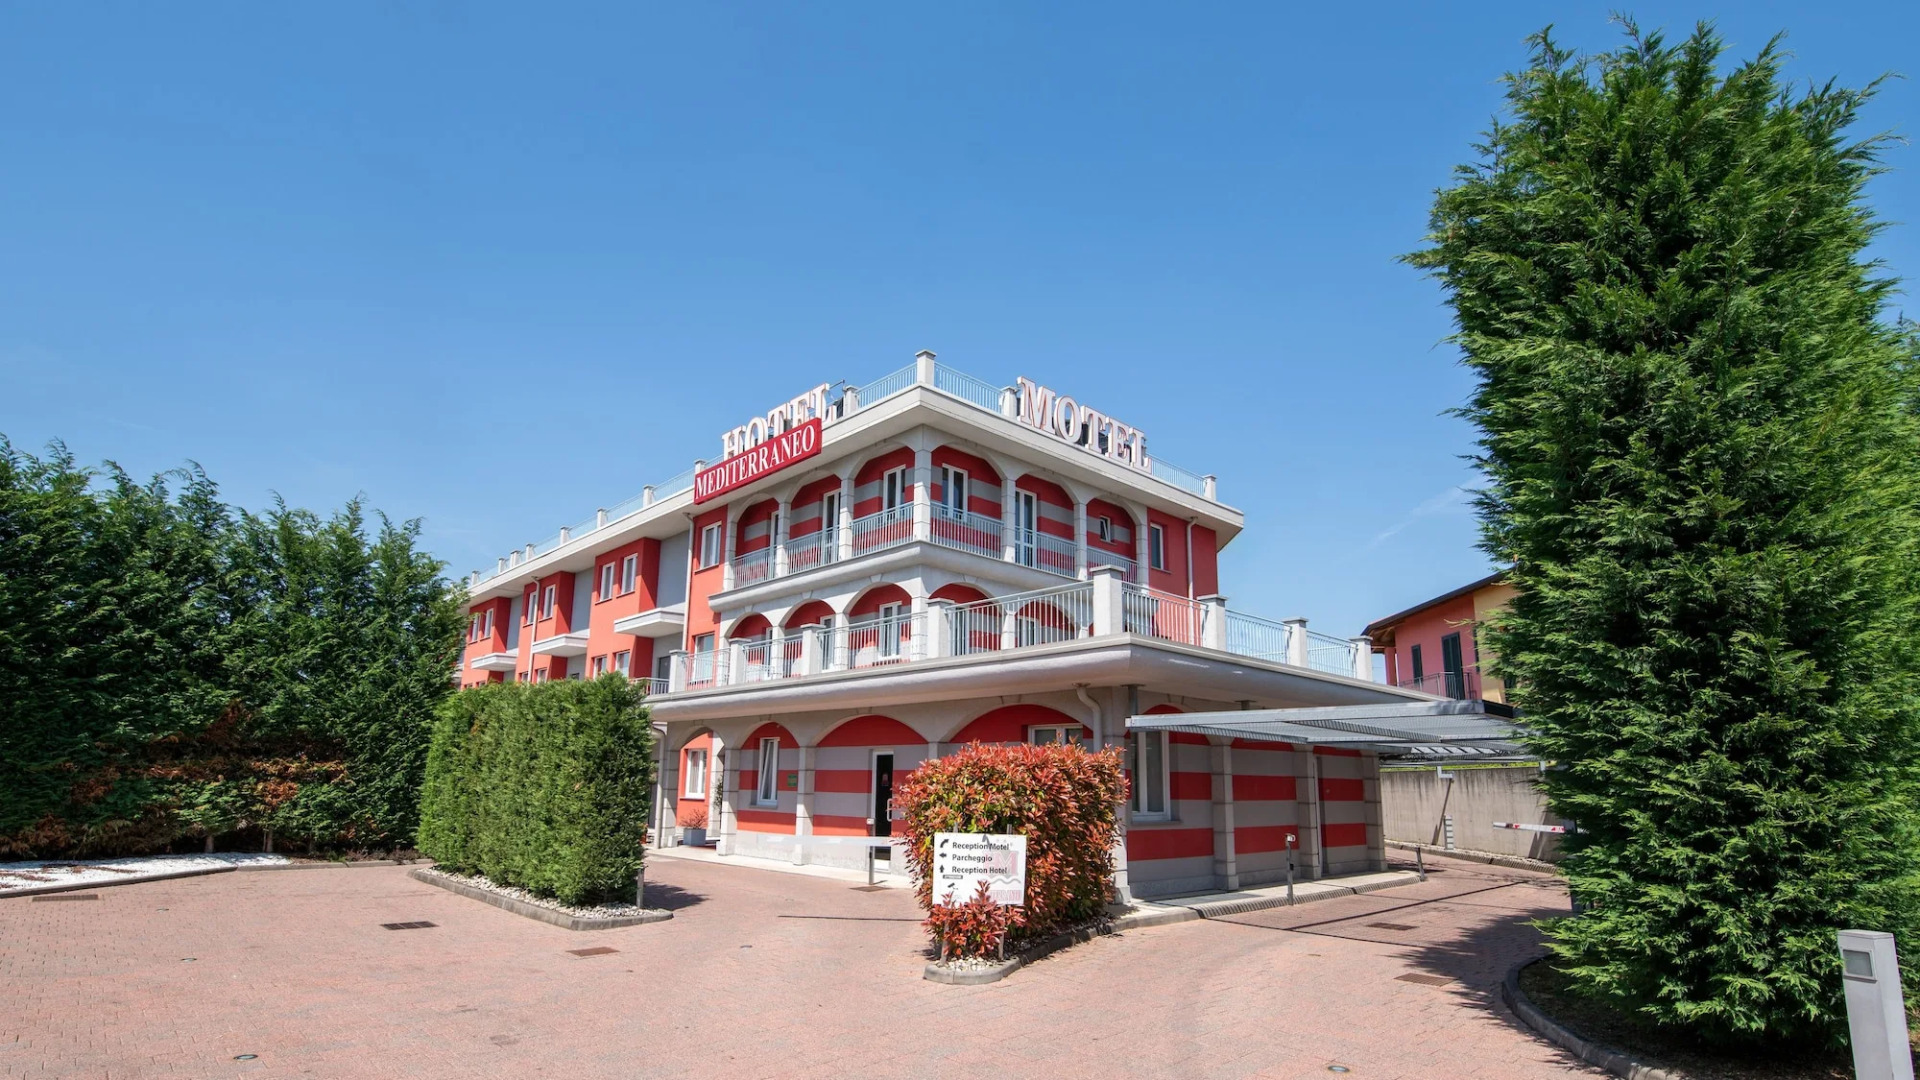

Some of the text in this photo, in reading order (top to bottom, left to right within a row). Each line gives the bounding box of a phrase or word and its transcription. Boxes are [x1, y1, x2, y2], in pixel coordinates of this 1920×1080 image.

[721, 383, 837, 461] HOTEL
[1017, 376, 1152, 474] MOTEL
[695, 425, 815, 500] MEDITERRANEO
[952, 842, 1009, 851] Reception Motel
[952, 854, 993, 863] Parcheggio
[952, 866, 988, 875] Reception
